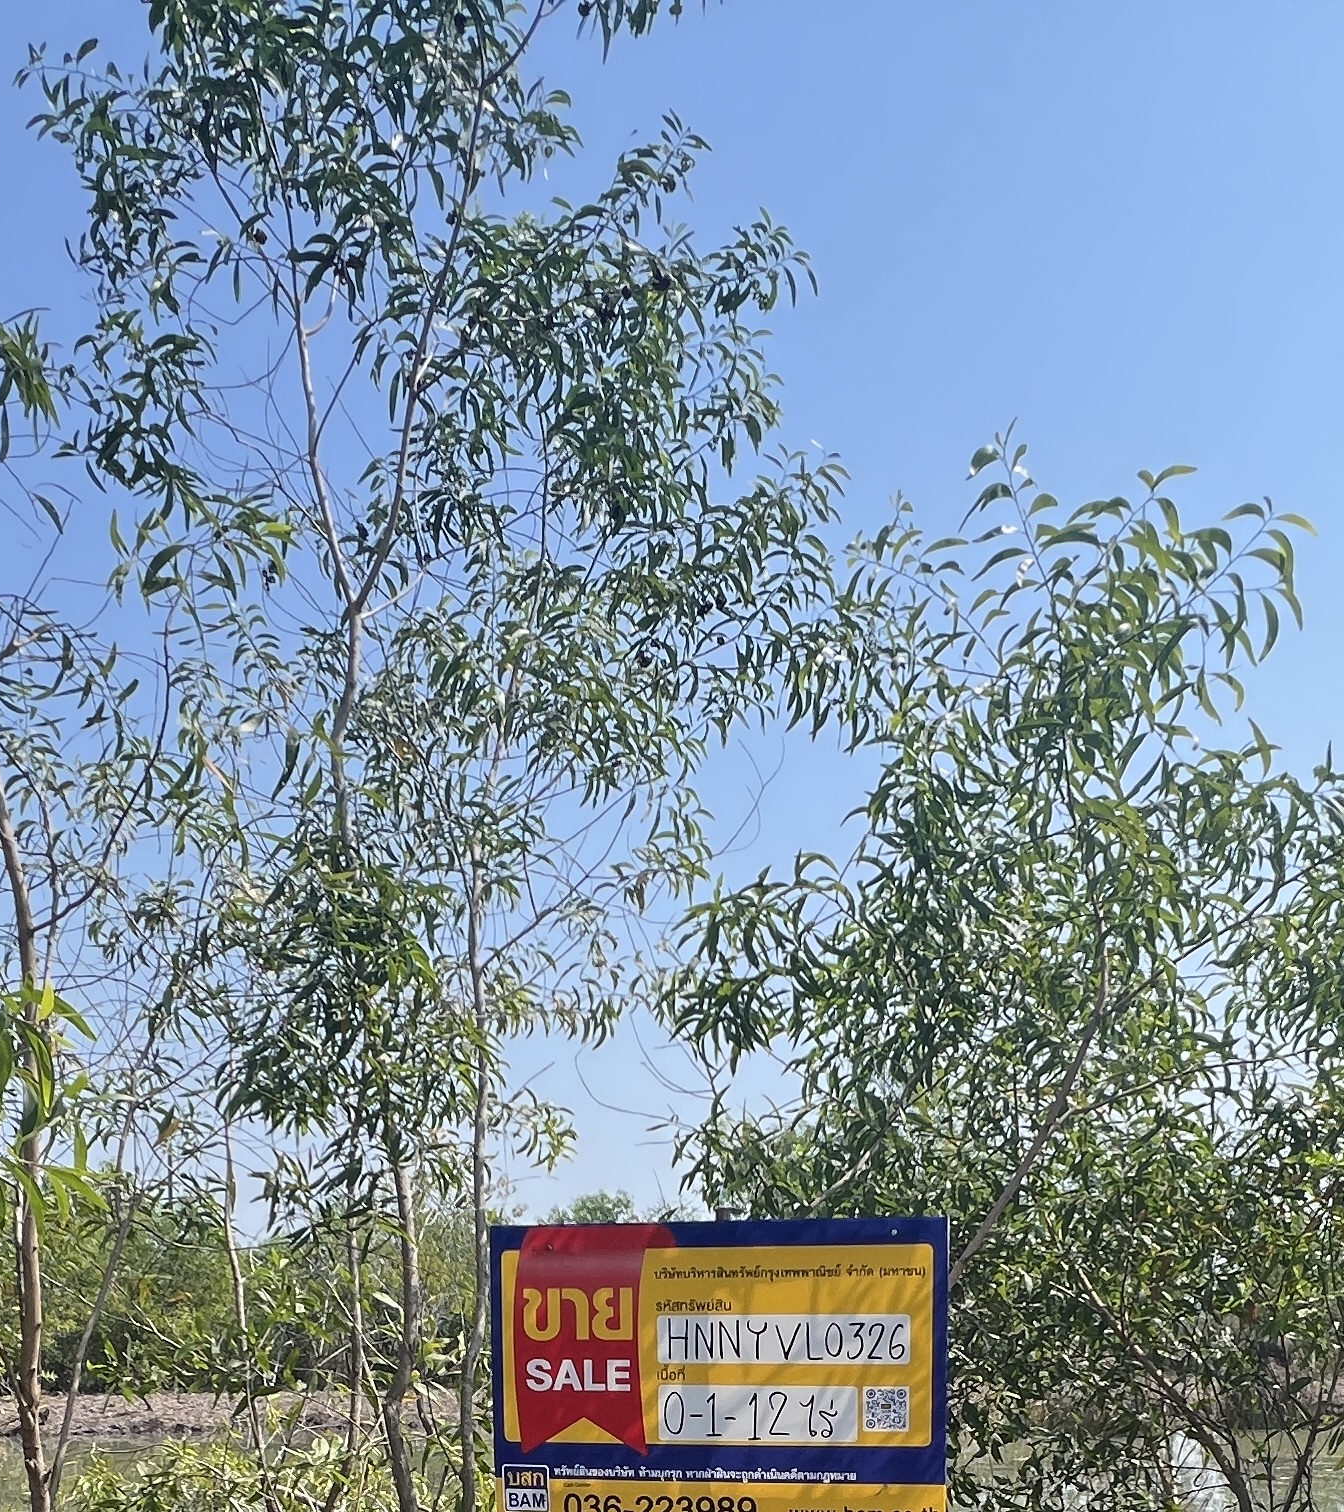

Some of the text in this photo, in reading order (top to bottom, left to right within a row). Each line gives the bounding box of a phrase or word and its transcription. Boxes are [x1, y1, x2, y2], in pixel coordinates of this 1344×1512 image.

[845, 1264, 874, 1278] จำกัด
[878, 1266, 926, 1279] (มหาชน)
[523, 1287, 633, 1341] ขาย
[655, 1298, 732, 1313] รหัสทรัพย์สิน
[525, 1358, 632, 1393] SALE
[656, 1366, 686, 1382] เนื้อที่
[664, 1391, 792, 1441] 0-1-12
[506, 1470, 545, 1487] บสก
[508, 1491, 546, 1509] BAM
